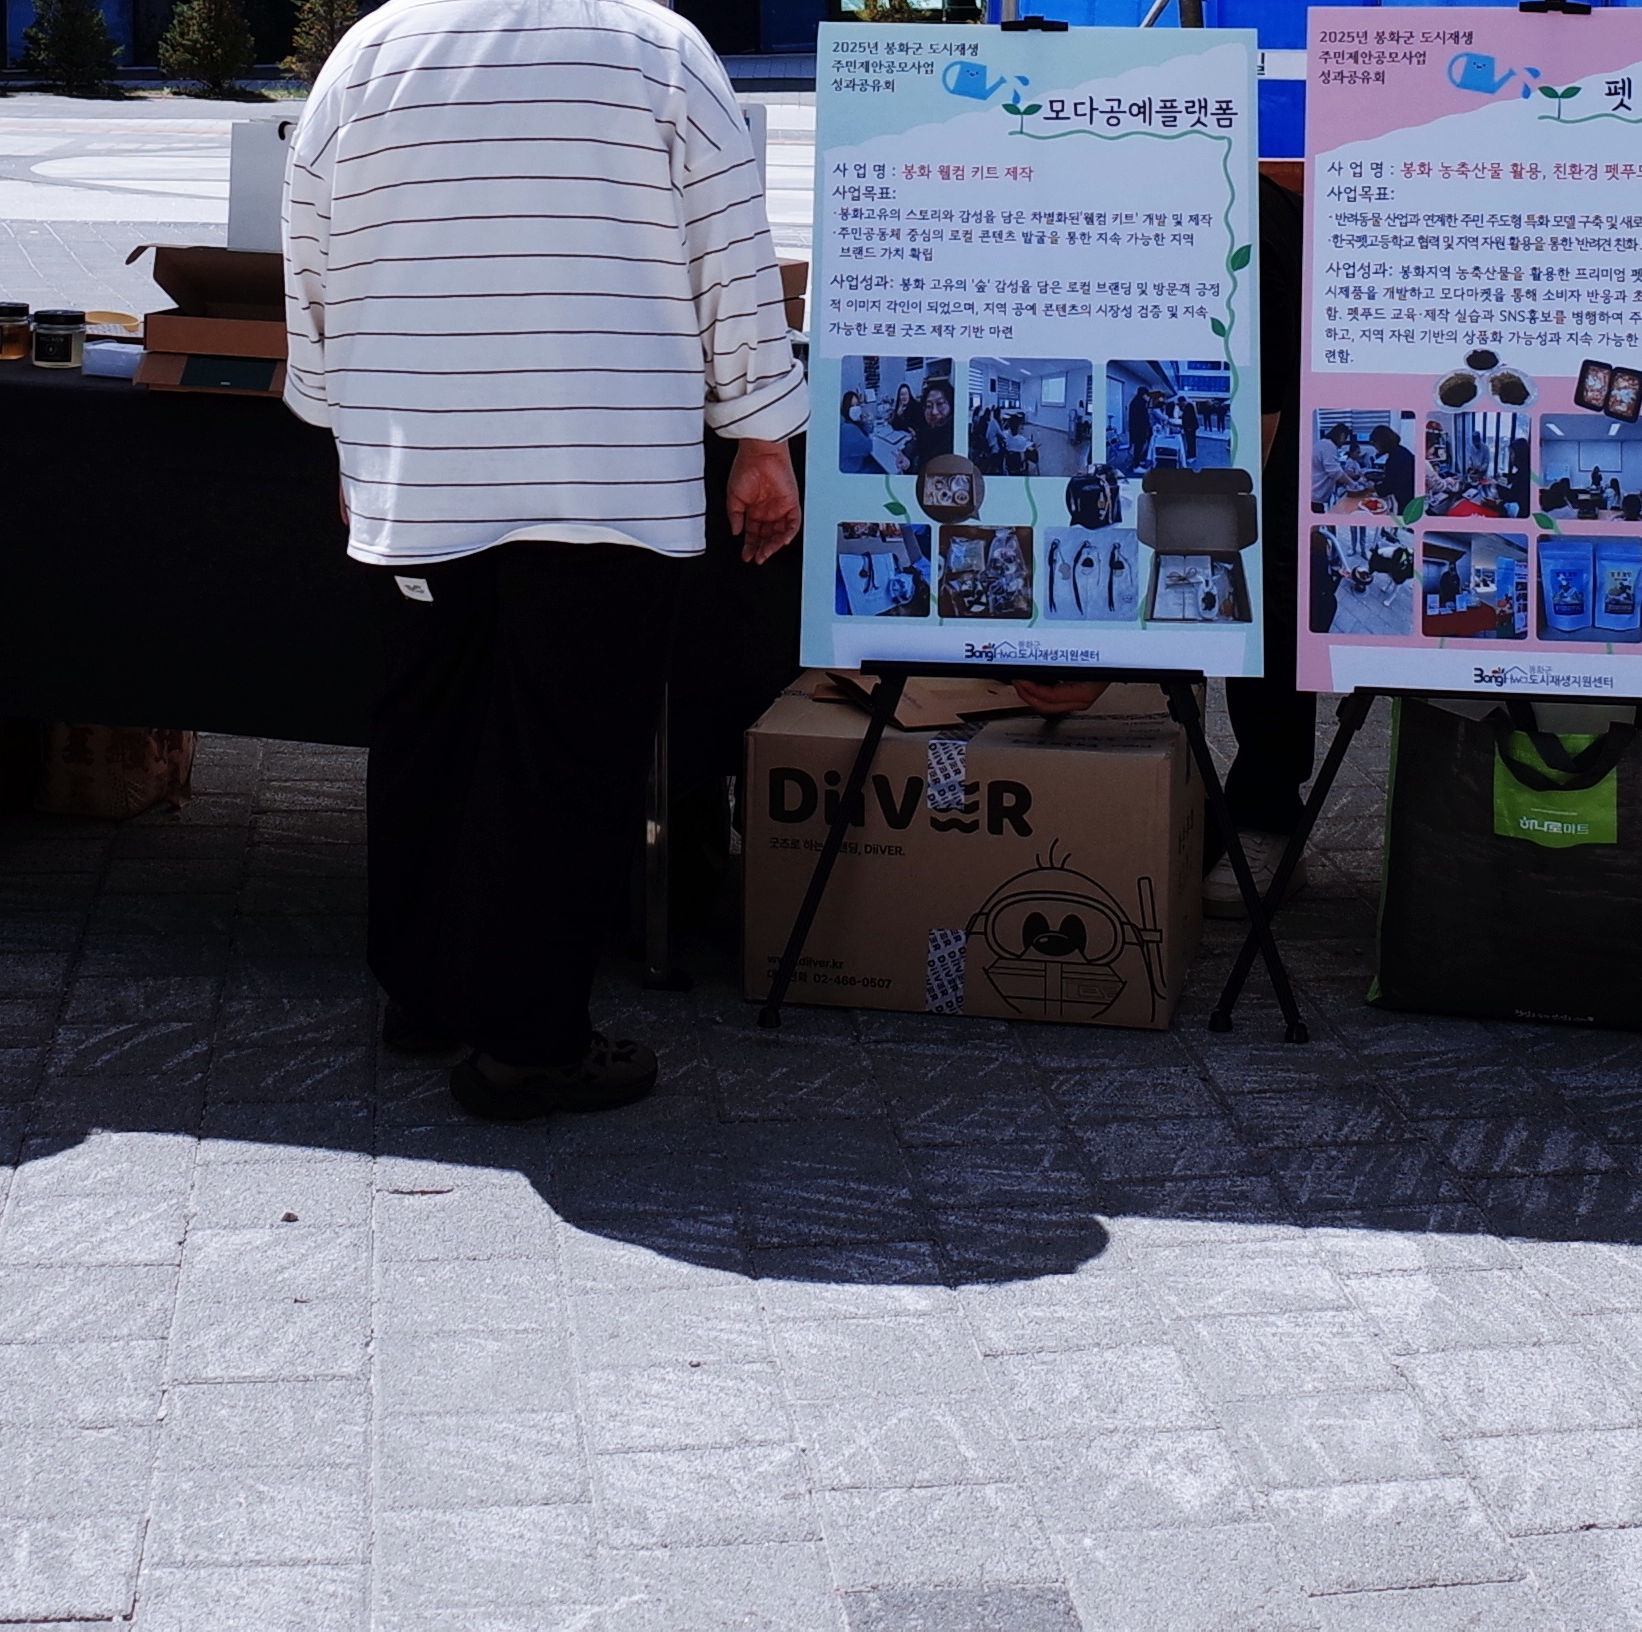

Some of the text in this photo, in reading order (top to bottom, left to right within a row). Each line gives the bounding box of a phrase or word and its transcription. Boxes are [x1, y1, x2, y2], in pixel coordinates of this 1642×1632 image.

[1319, 30, 1473, 45] 2025년 봉화군 도시재생
[832, 41, 978, 56] 2025년 봉화군 도시재생
[1318, 50, 1426, 65] 주민제안공모사업
[831, 59, 934, 74] 주민제안공모사업
[831, 77, 895, 92] 성과공유회
[1318, 69, 1385, 85] 성과공유회
[1604, 77, 1632, 111] 펫
[1043, 97, 1237, 128] 모다공예플랫폼
[901, 163, 1034, 182] 봉화 웰컴 키트 제작
[1400, 161, 1433, 179] 봉화
[1438, 161, 1503, 179] 농축산물
[1509, 162, 1546, 180] 활용,
[1553, 163, 1598, 180] 친환경
[832, 185, 896, 201] 사업목표:
[1326, 185, 1394, 203] 사업목표:
[905, 209, 955, 222] 스토리와
[958, 209, 996, 224] 감성을
[1000, 210, 1026, 224] 담은
[1142, 213, 1167, 227] 개발
[1171, 213, 1183, 227] 및
[1187, 213, 1213, 227] 제작
[906, 228, 943, 242] 중심의
[948, 229, 973, 243] 로컬
[978, 229, 1016, 243] 콘텐츠
[1021, 230, 1060, 245] 발굴을
[1065, 231, 1092, 245] 통한
[1096, 231, 1122, 246] 지속
[1126, 232, 1166, 246] 가능한
[1170, 232, 1194, 246] 지역
[839, 246, 933, 261] 브랜드 가치 확립
[1325, 261, 1393, 279] 사업성과:
[1399, 265, 1451, 280] 봉화지역
[1455, 265, 1525, 281] 농축산물을
[1529, 266, 1570, 282] 활용한
[1574, 267, 1625, 282] 프리미엄
[830, 274, 893, 291] 사업성과:
[899, 277, 926, 292] 봉화
[929, 278, 967, 291] 고유의
[995, 279, 1032, 294] 감성을
[1036, 280, 1062, 294] 담은
[1066, 281, 1091, 295] 로컬
[1095, 281, 1131, 295] 브랜딩
[1136, 281, 1148, 296] 및
[1152, 282, 1190, 296] 방문객
[1194, 282, 1220, 297] 긍정
[829, 298, 1208, 319] 적 이미지 각인이 되었으며, 지역 공예 콘텐츠의 시장성 검증 및 지속
[1018, 649, 1099, 661] 도시재생지원센터
[1529, 674, 1613, 688] 도시재생지원센터
